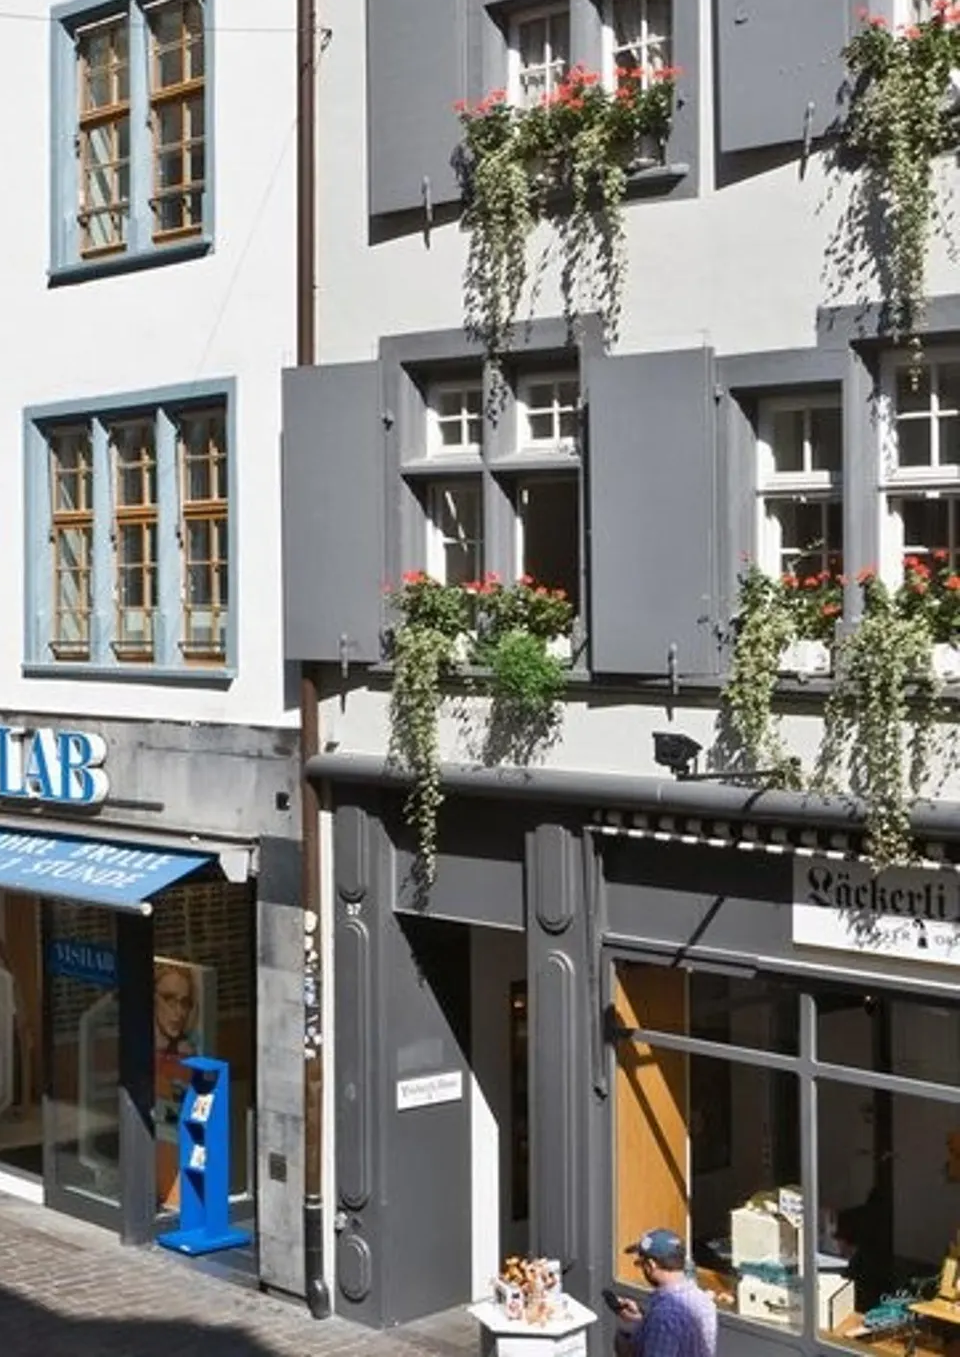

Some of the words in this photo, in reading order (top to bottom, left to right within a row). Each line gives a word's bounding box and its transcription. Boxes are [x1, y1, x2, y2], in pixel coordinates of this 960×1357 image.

[21, 857, 146, 889] STUNDE
[70, 844, 176, 871] BRILLE
[807, 867, 945, 920] Läckerli
